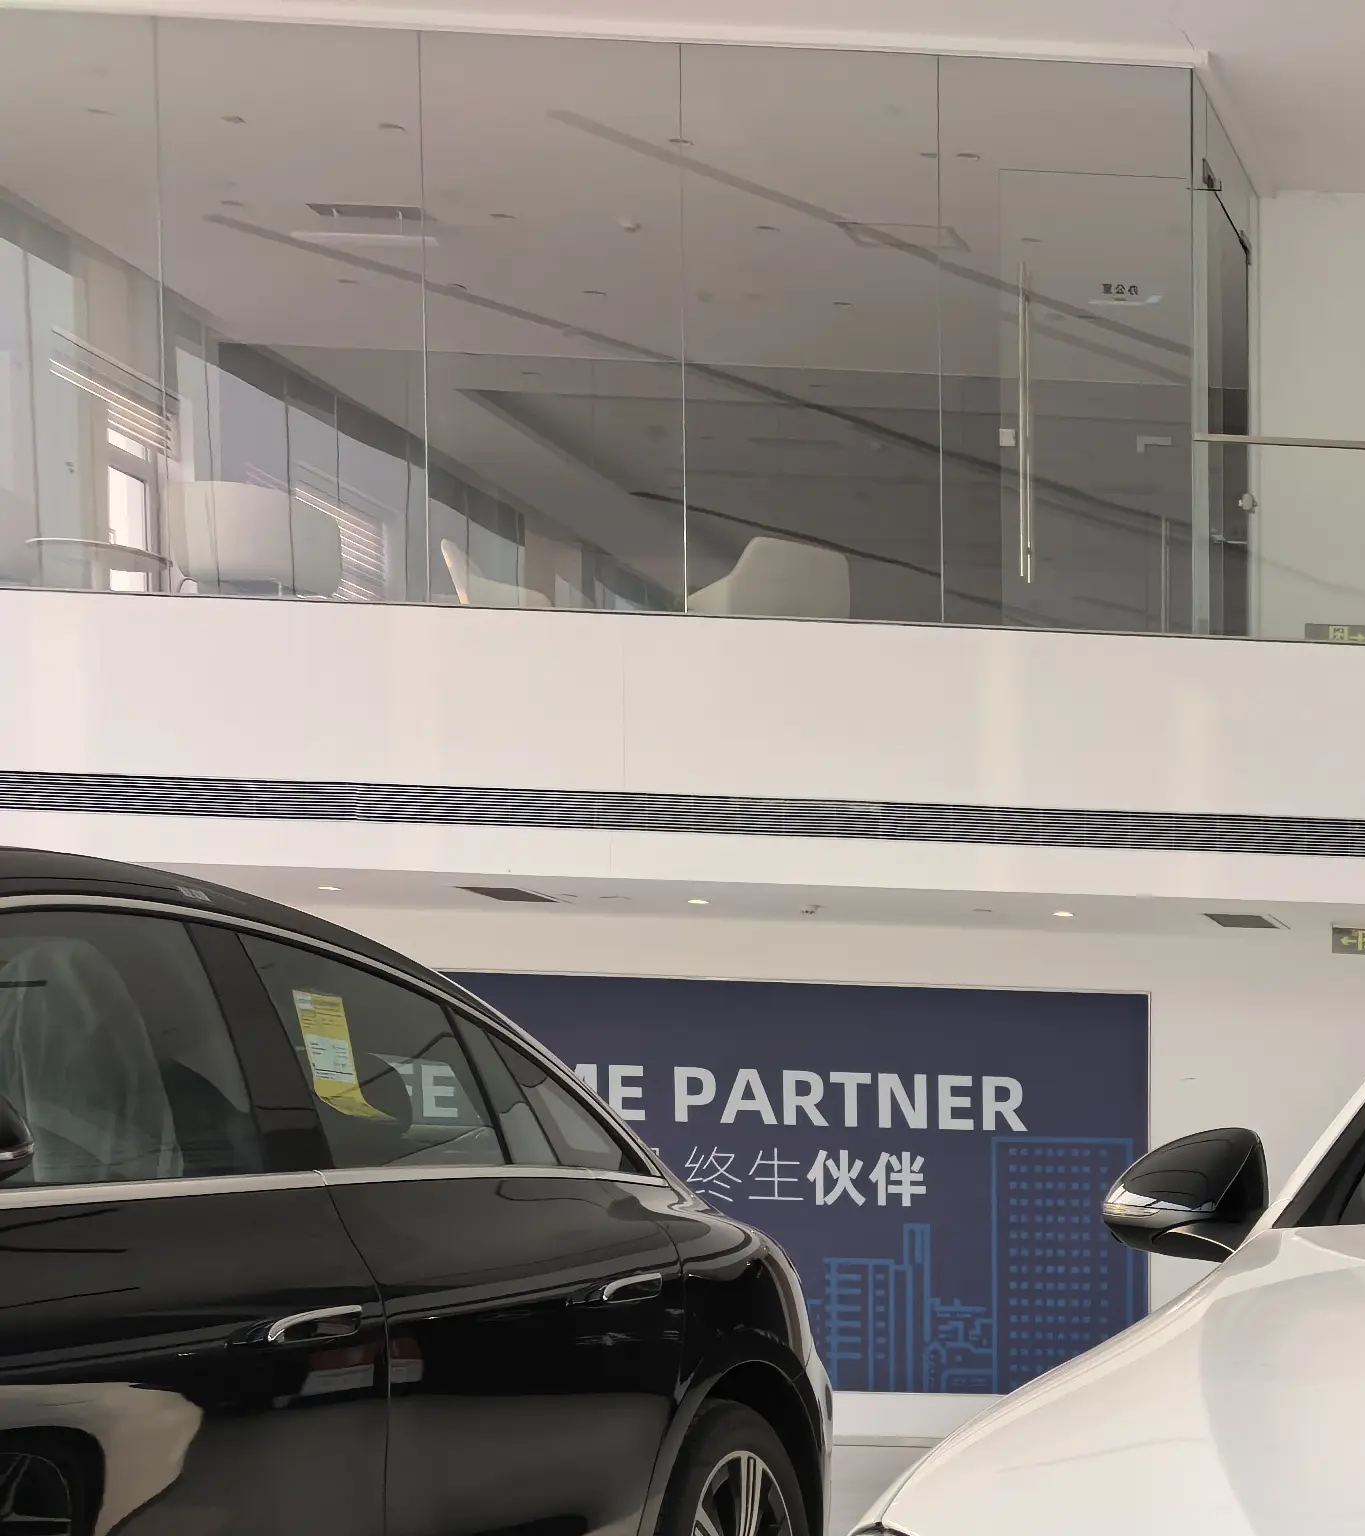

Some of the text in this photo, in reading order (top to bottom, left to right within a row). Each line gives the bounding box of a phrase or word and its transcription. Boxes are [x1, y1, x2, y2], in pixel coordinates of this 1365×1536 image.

[673, 1066, 1028, 1133] PARTNER
[651, 1145, 928, 1209] 终生伙伴
